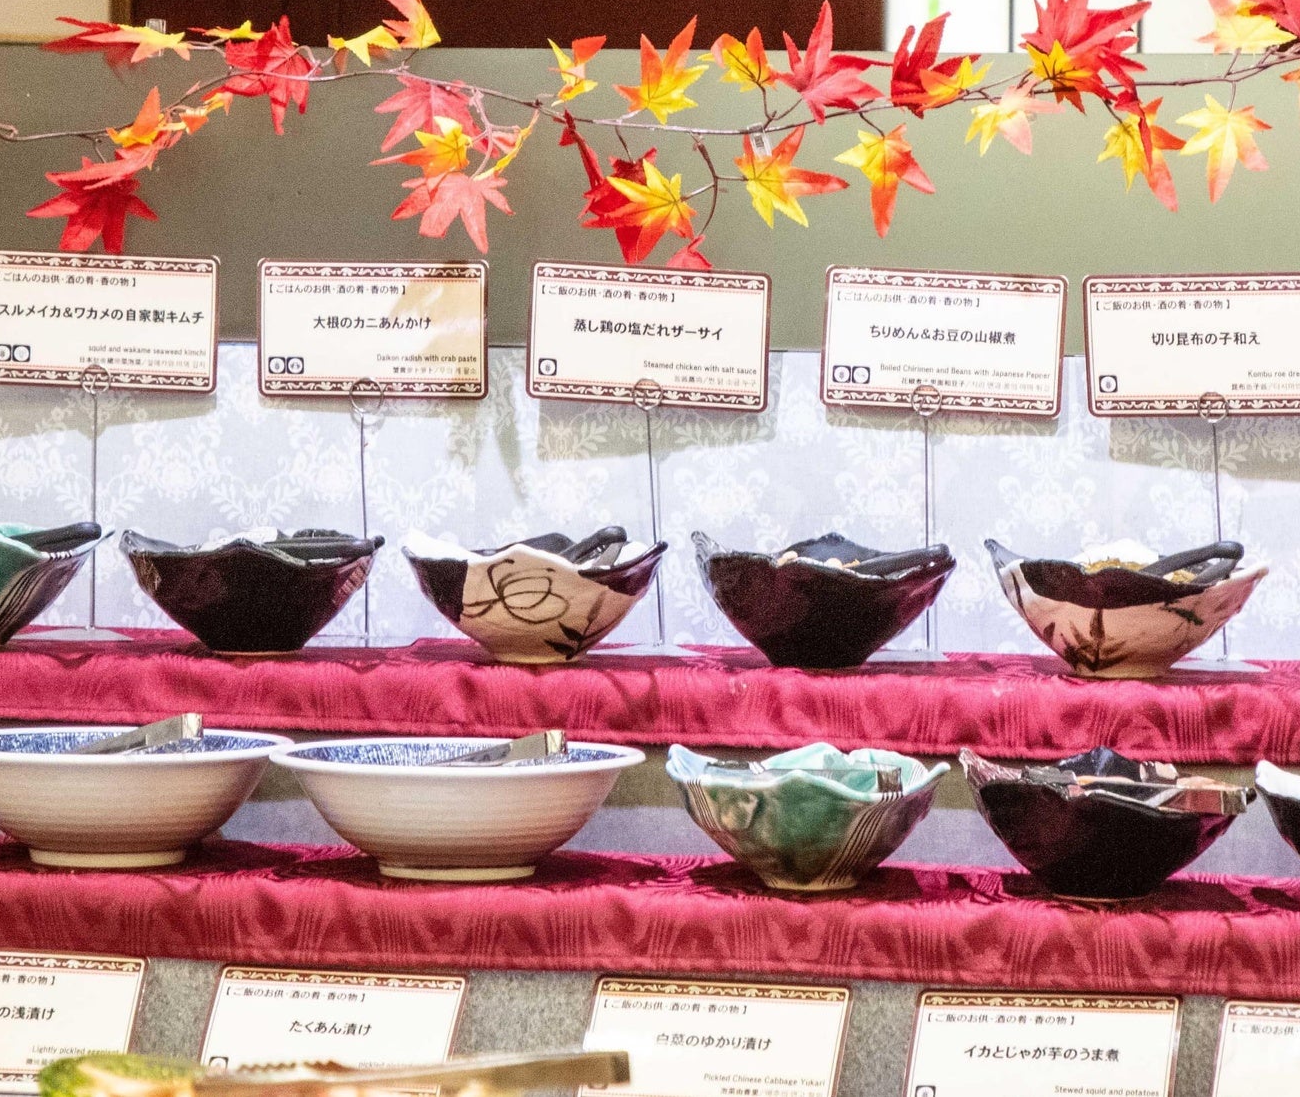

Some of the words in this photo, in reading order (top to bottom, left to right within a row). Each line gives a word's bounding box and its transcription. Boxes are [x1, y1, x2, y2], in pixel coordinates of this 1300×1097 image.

[313, 316, 431, 329] 大根のカニあんかけ
[1151, 332, 1260, 346] 切り昆布の子和え
[401, 354, 423, 362] radish
[458, 355, 477, 363] paste
[643, 360, 674, 370] Steamed
[676, 362, 702, 372] chicken
[704, 364, 720, 372] with
[722, 365, 735, 374] salt
[737, 367, 757, 375] sauce
[951, 367, 972, 375] Beans
[289, 1021, 372, 1036] たくあん漬け
[1055, 1085, 1084, 1094] Stewed
[1109, 1087, 1123, 1095] and
